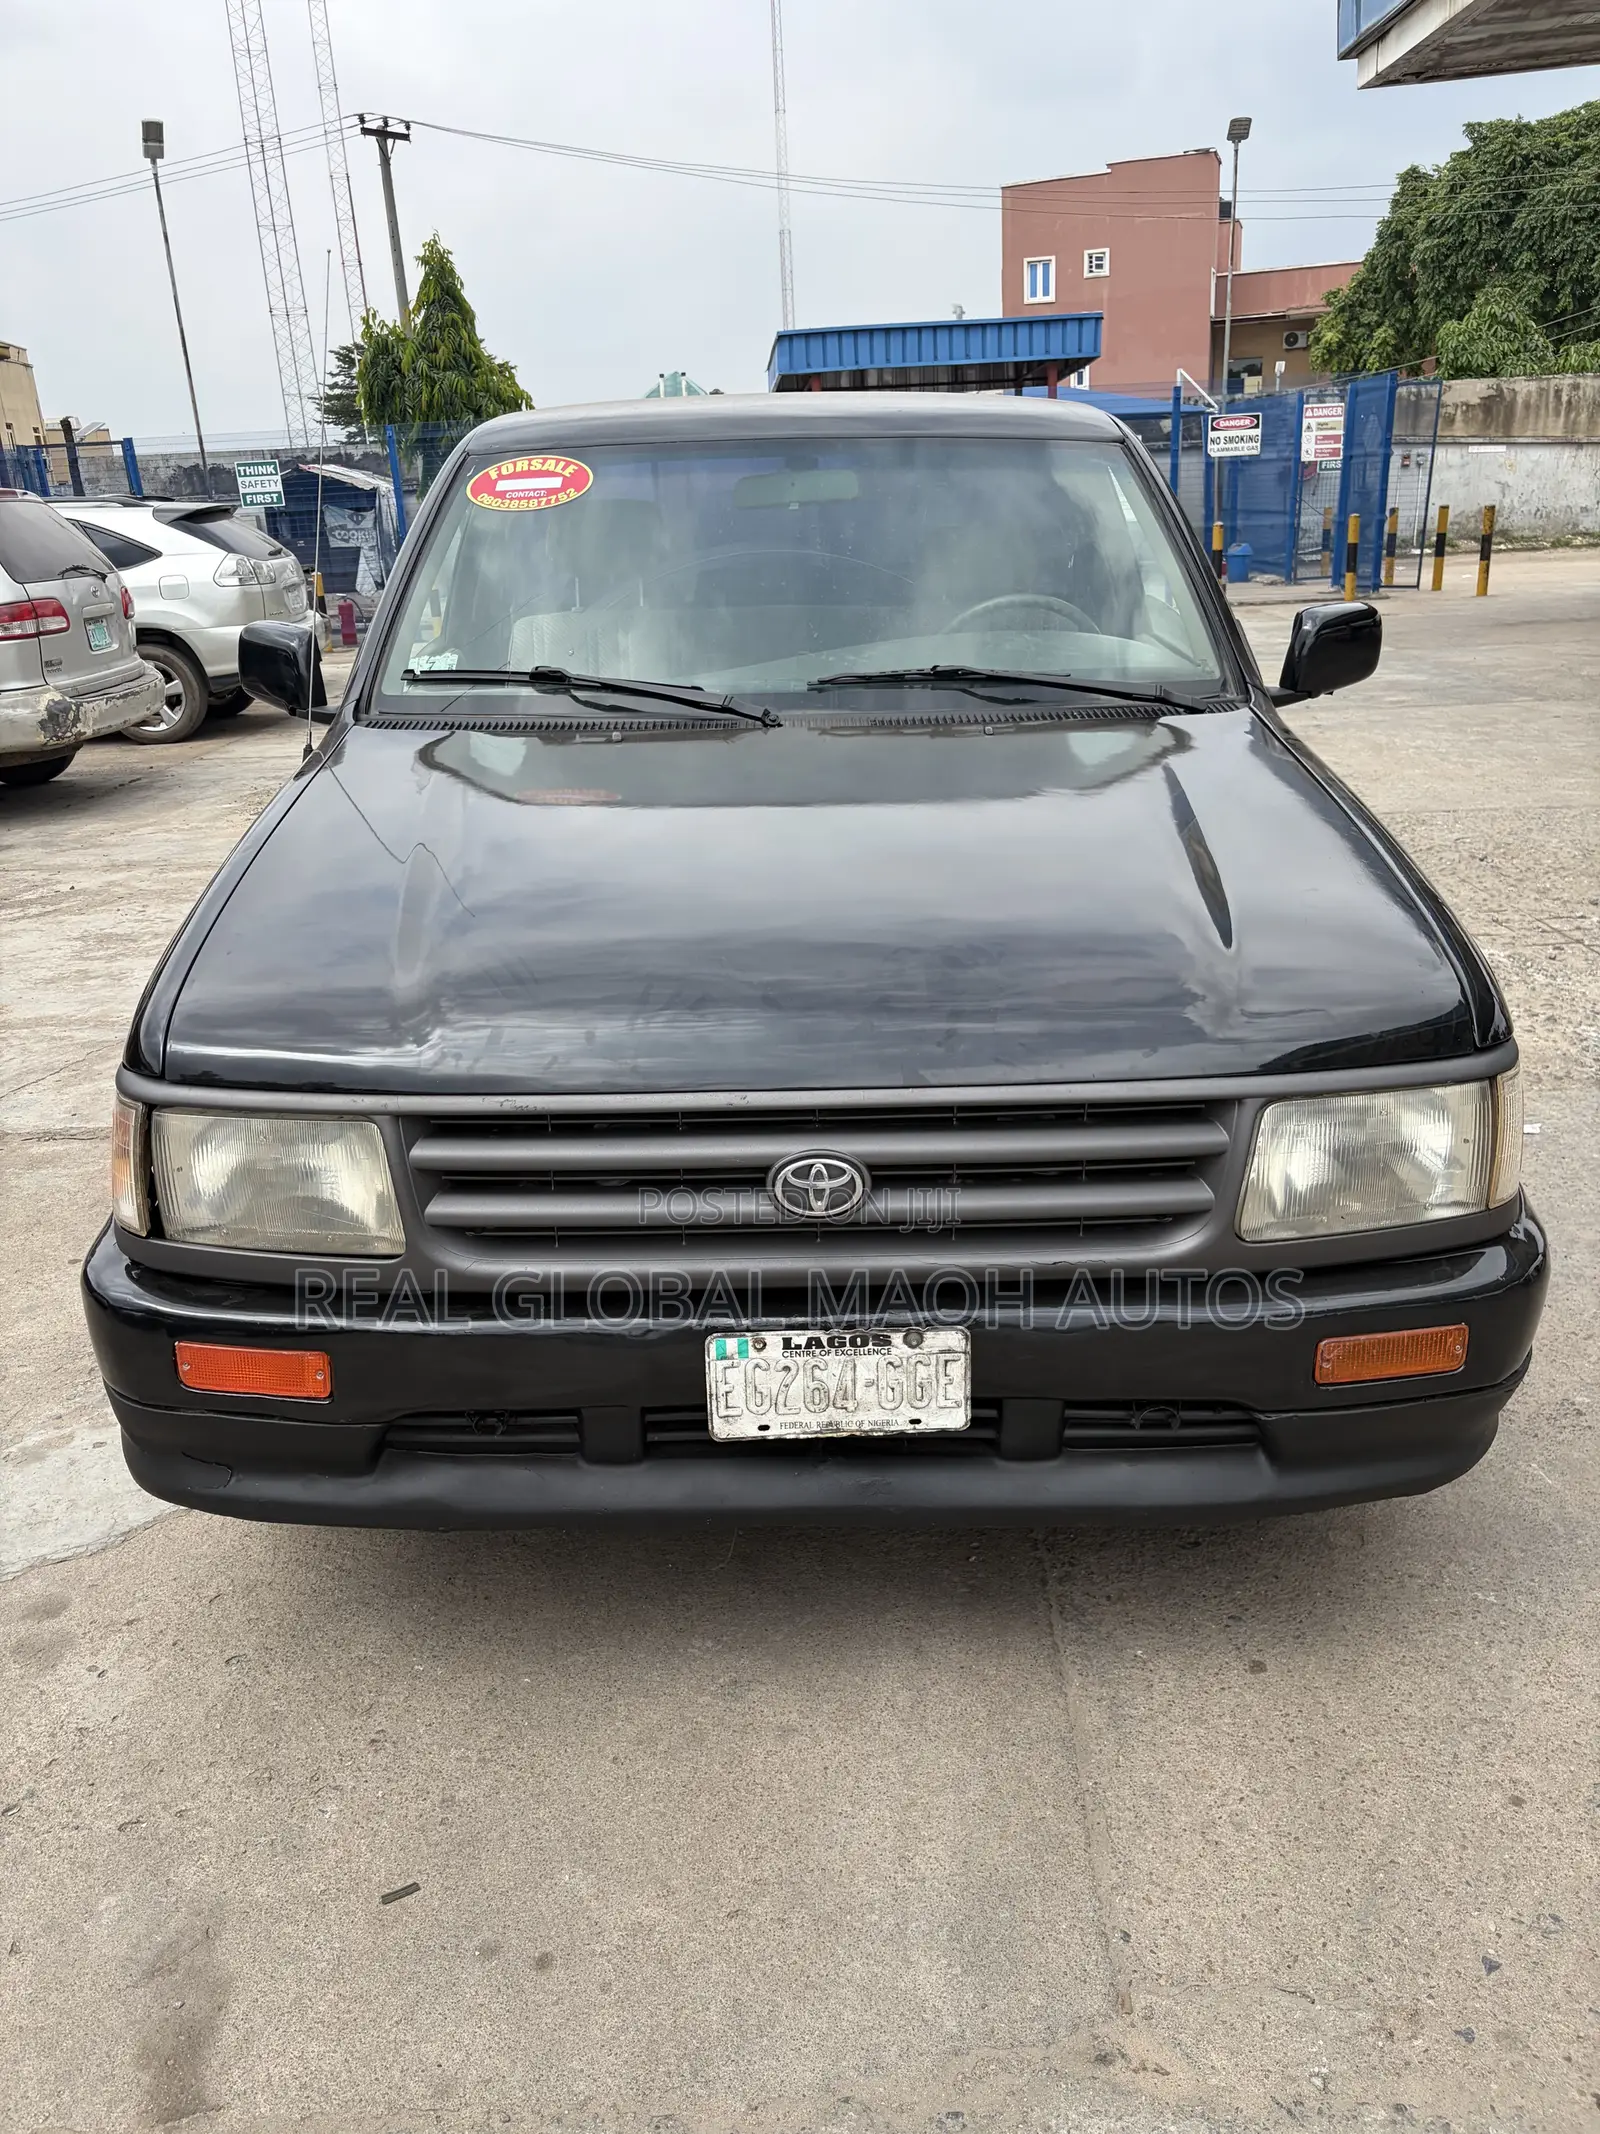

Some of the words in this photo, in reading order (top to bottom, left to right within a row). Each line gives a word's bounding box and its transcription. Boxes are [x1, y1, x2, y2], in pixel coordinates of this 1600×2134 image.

[1313, 407, 1342, 416] DANGER
[1219, 419, 1251, 427] DANGER
[1210, 436, 1221, 445] NO
[1223, 434, 1260, 445] SMOKING
[238, 464, 276, 476] THINK
[488, 459, 578, 480] FORSALE
[1321, 461, 1342, 469] FIRS
[240, 479, 279, 489] SAFETY
[246, 493, 278, 504] FIRST
[477, 487, 578, 509] 08038587752
[505, 490, 547, 499] CONTACT:
[781, 1334, 892, 1350] LAGOS
[781, 1350, 817, 1359] CENTRE
[834, 1347, 892, 1356] EXCELLENCE
[716, 1353, 962, 1418] EG264-GGE
[779, 1421, 813, 1430] FEDERAL
[816, 1420, 854, 1429] REPUBLIC
[855, 1420, 865, 1428] OF
[867, 1419, 899, 1427] NIGERIA
